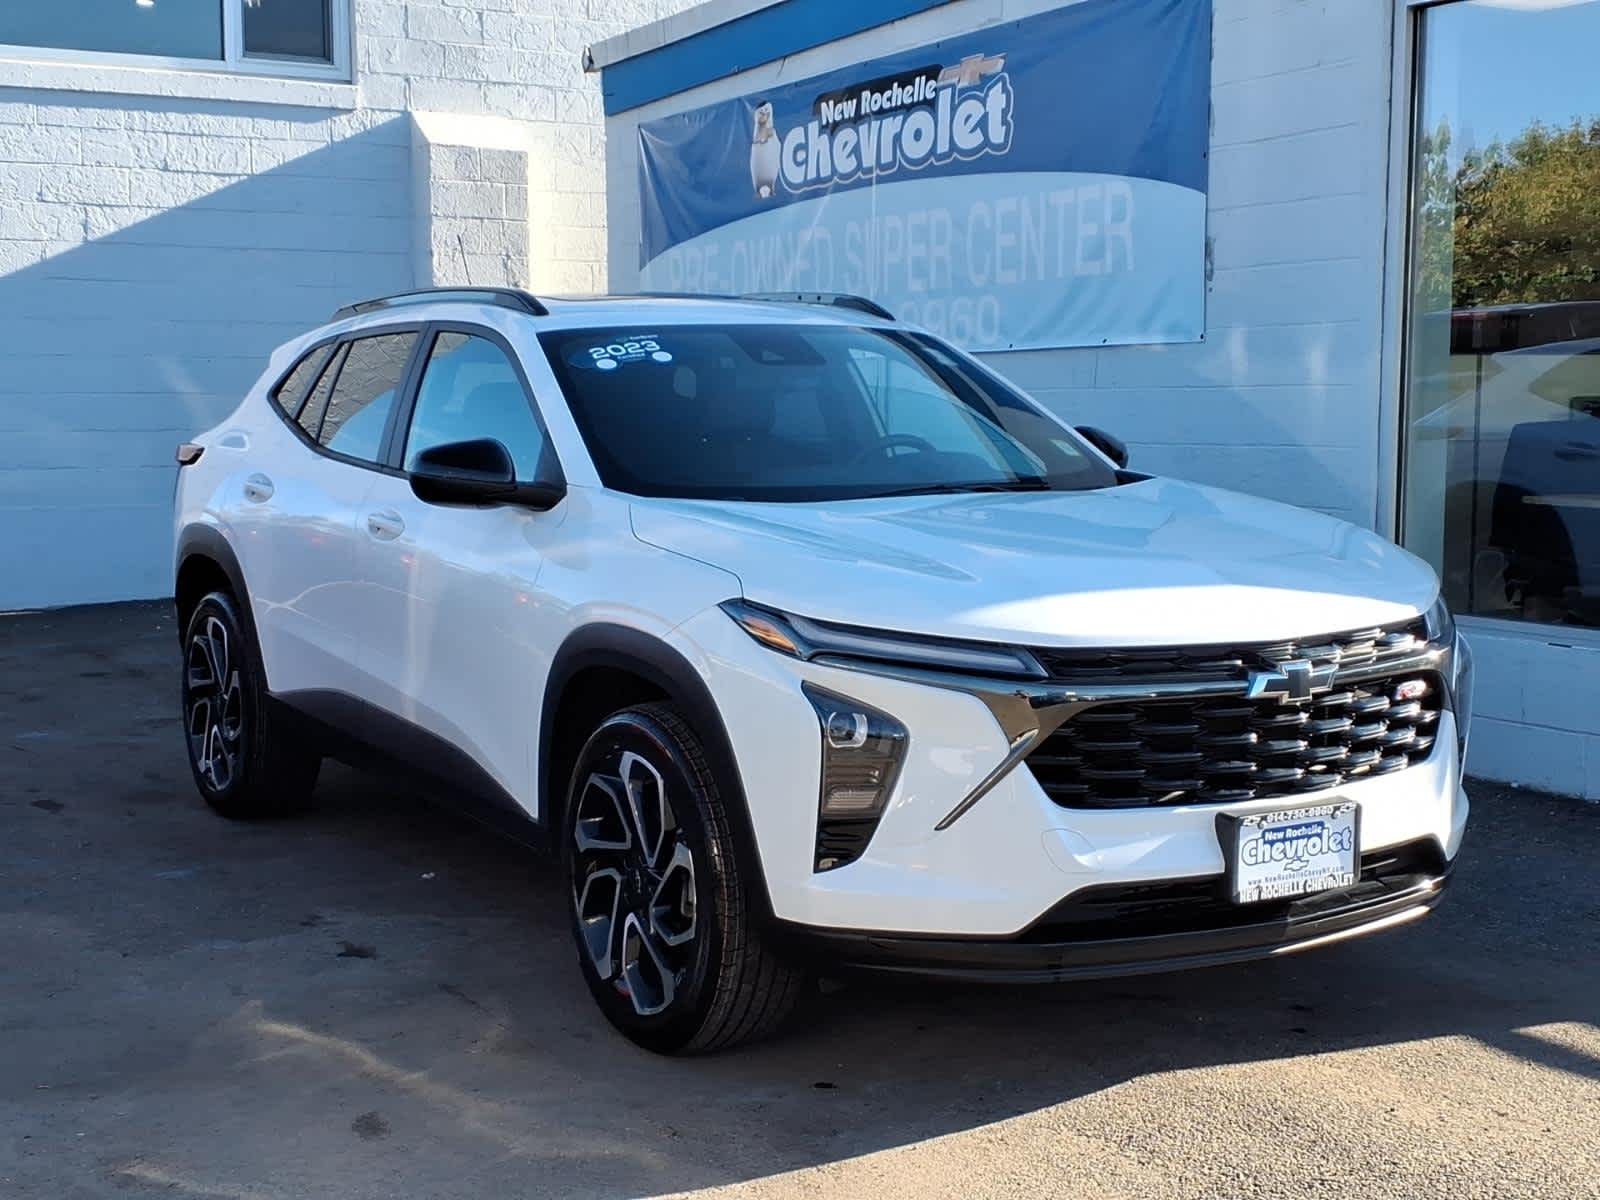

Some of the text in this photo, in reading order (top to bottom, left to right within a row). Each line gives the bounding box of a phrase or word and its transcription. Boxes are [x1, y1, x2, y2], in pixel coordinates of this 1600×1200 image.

[820, 75, 937, 126] New Rochelle
[781, 79, 1009, 186] Chevrolet
[844, 211, 954, 300] SUPER
[966, 181, 1136, 287] CENTER
[588, 340, 660, 359] 2023
[1241, 826, 1352, 866] Chevrolet
[1264, 823, 1322, 842] New Rochelle
[1240, 872, 1354, 904] NEW ROCHELLE CHEVROLET
